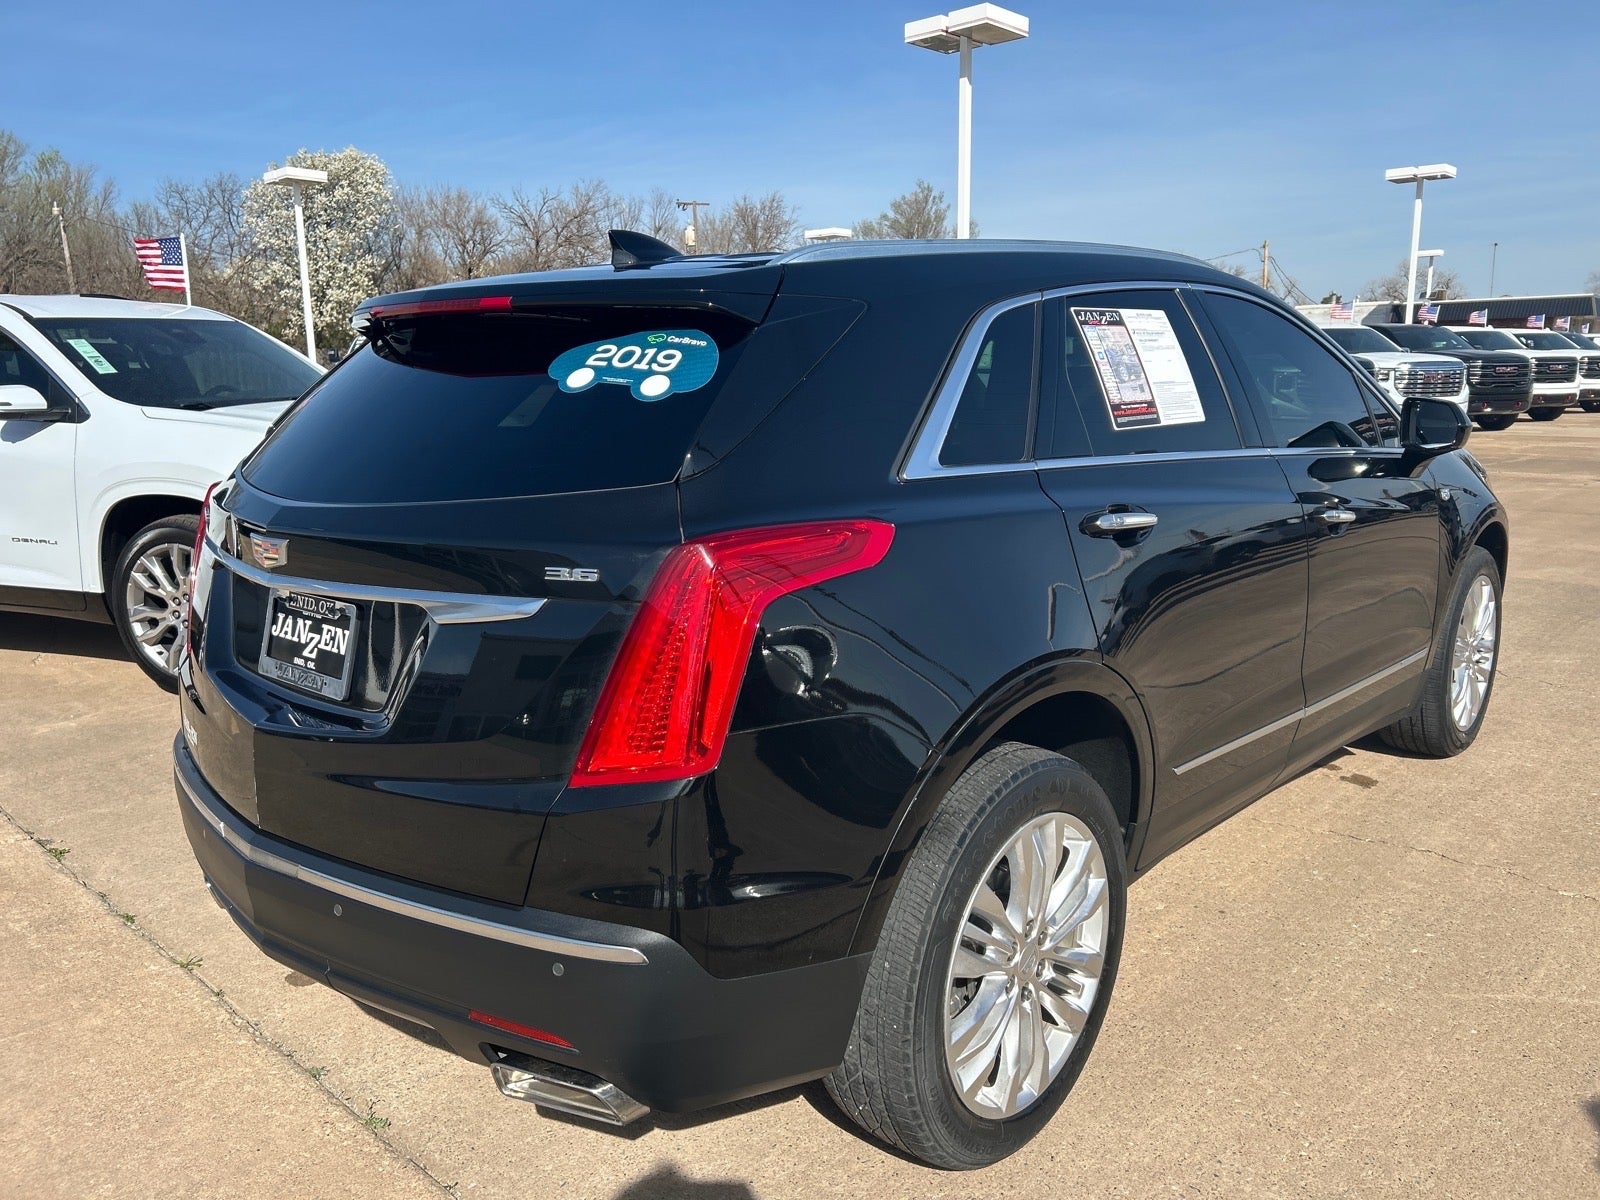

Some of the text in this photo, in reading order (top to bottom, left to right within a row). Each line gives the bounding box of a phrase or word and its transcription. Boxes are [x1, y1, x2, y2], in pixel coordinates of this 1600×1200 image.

[1079, 311, 1120, 325] JANZEN
[667, 335, 708, 347] CarBravo
[585, 344, 683, 372] 2019
[11, 537, 58, 545] DENALI
[271, 612, 350, 659] JANZEN
[277, 664, 325, 688] JANZEN
